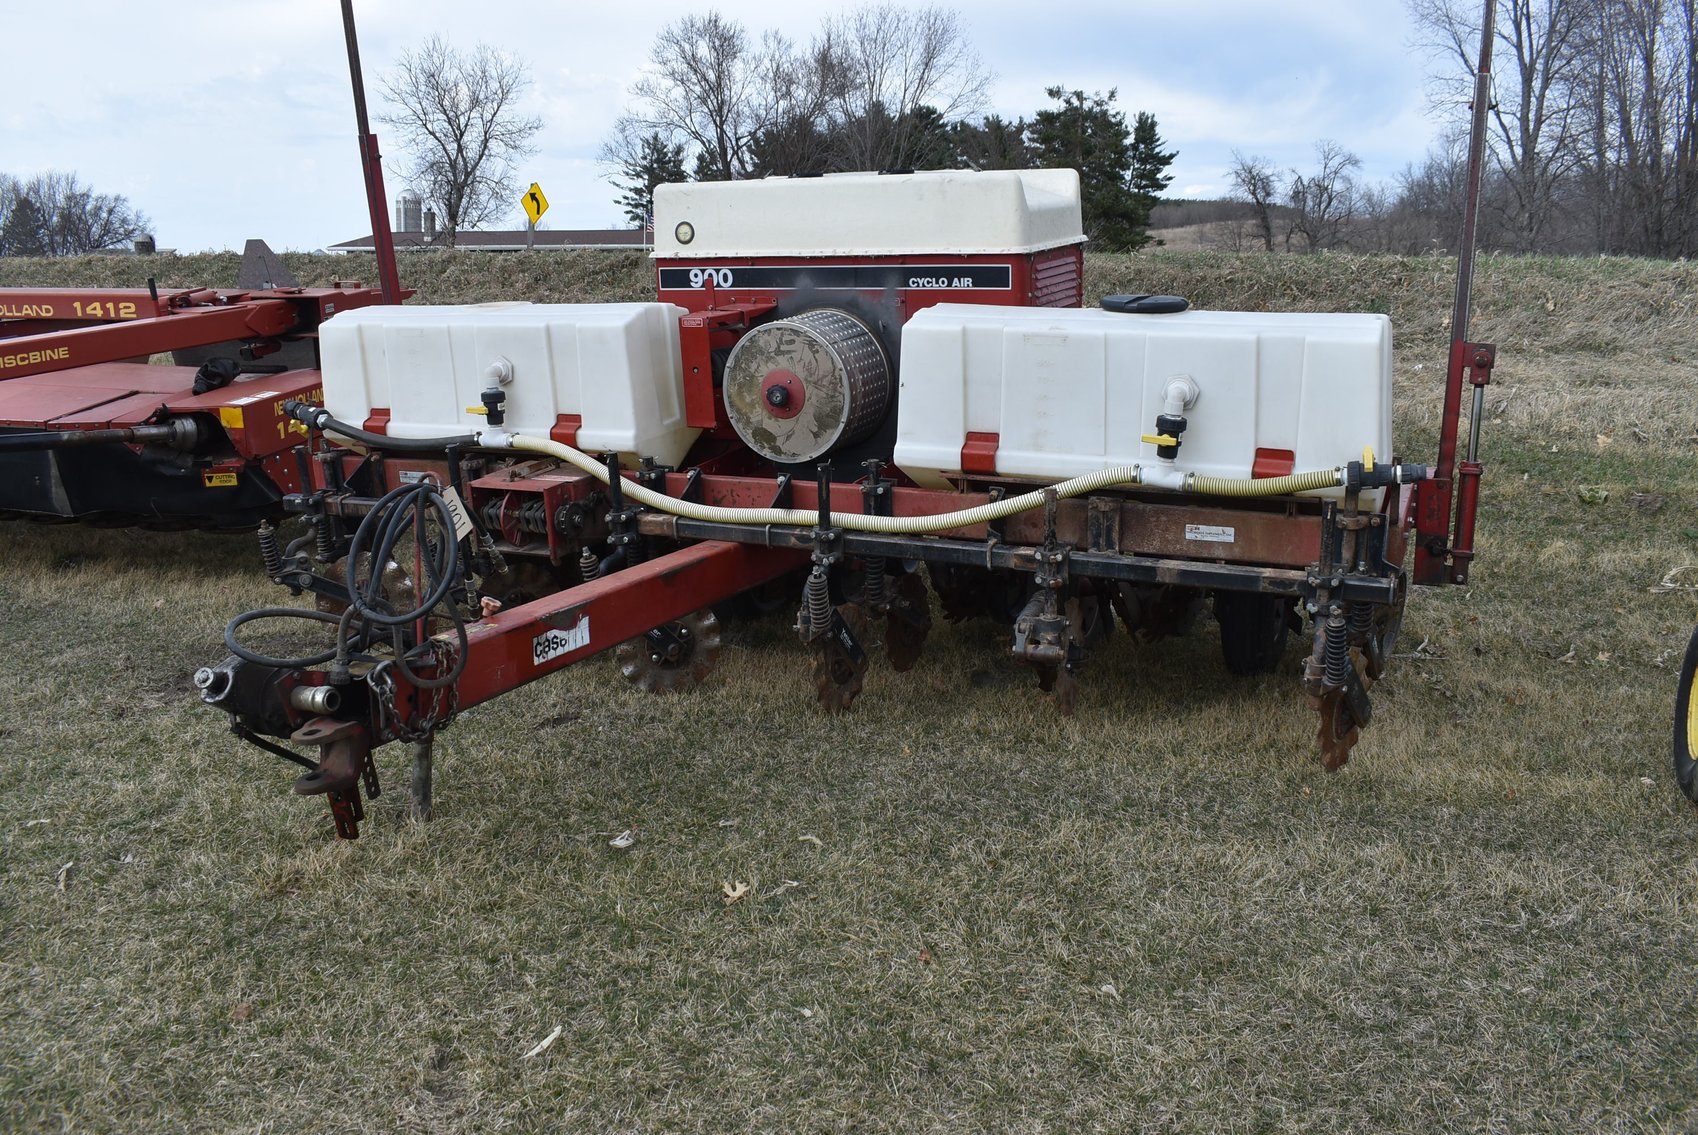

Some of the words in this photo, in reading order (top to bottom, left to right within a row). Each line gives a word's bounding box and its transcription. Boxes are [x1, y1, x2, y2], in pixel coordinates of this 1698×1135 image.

[689, 268, 733, 288] 900
[909, 278, 948, 287] CYCLO
[951, 278, 973, 287] AIR
[72, 301, 137, 318] 1412
